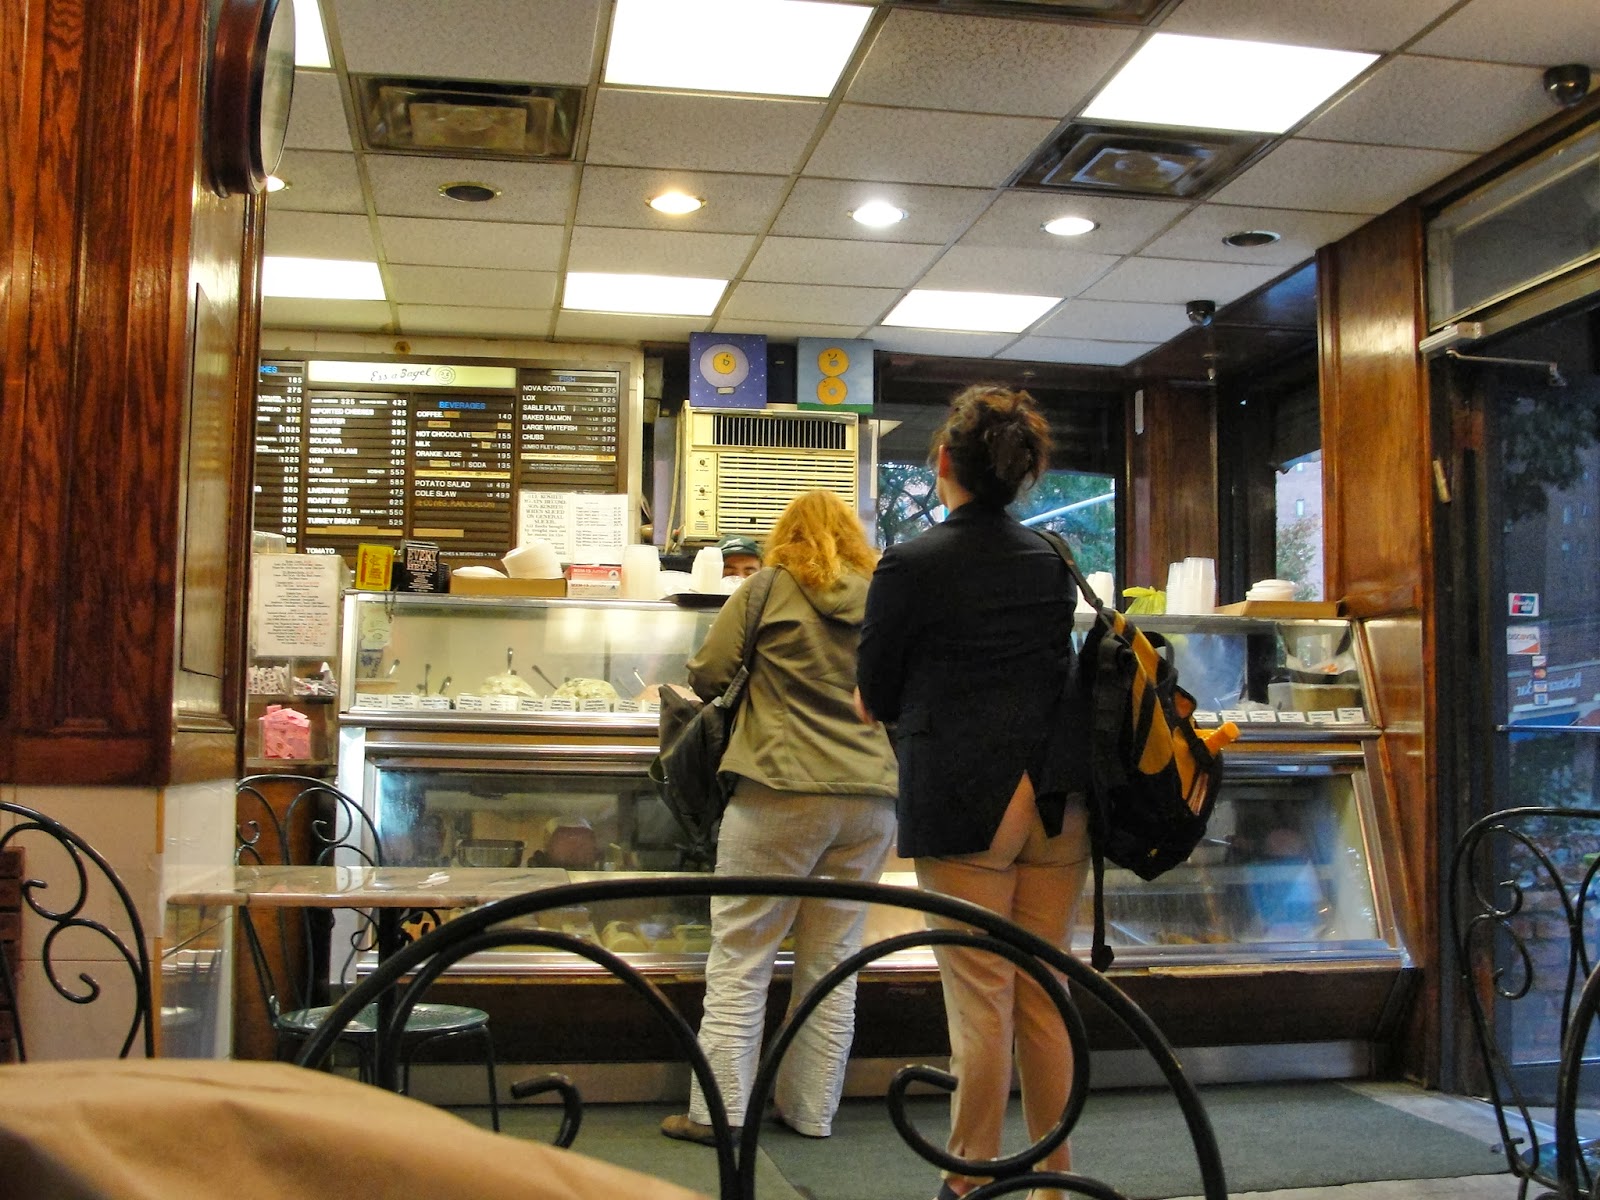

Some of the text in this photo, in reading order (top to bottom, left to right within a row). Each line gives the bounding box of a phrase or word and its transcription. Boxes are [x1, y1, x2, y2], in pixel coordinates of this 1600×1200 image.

[400, 367, 432, 382] Bagel
[439, 401, 486, 409] BEVERAGES
[431, 431, 471, 439] CHOCOLATE
[407, 549, 438, 561] EVERY
